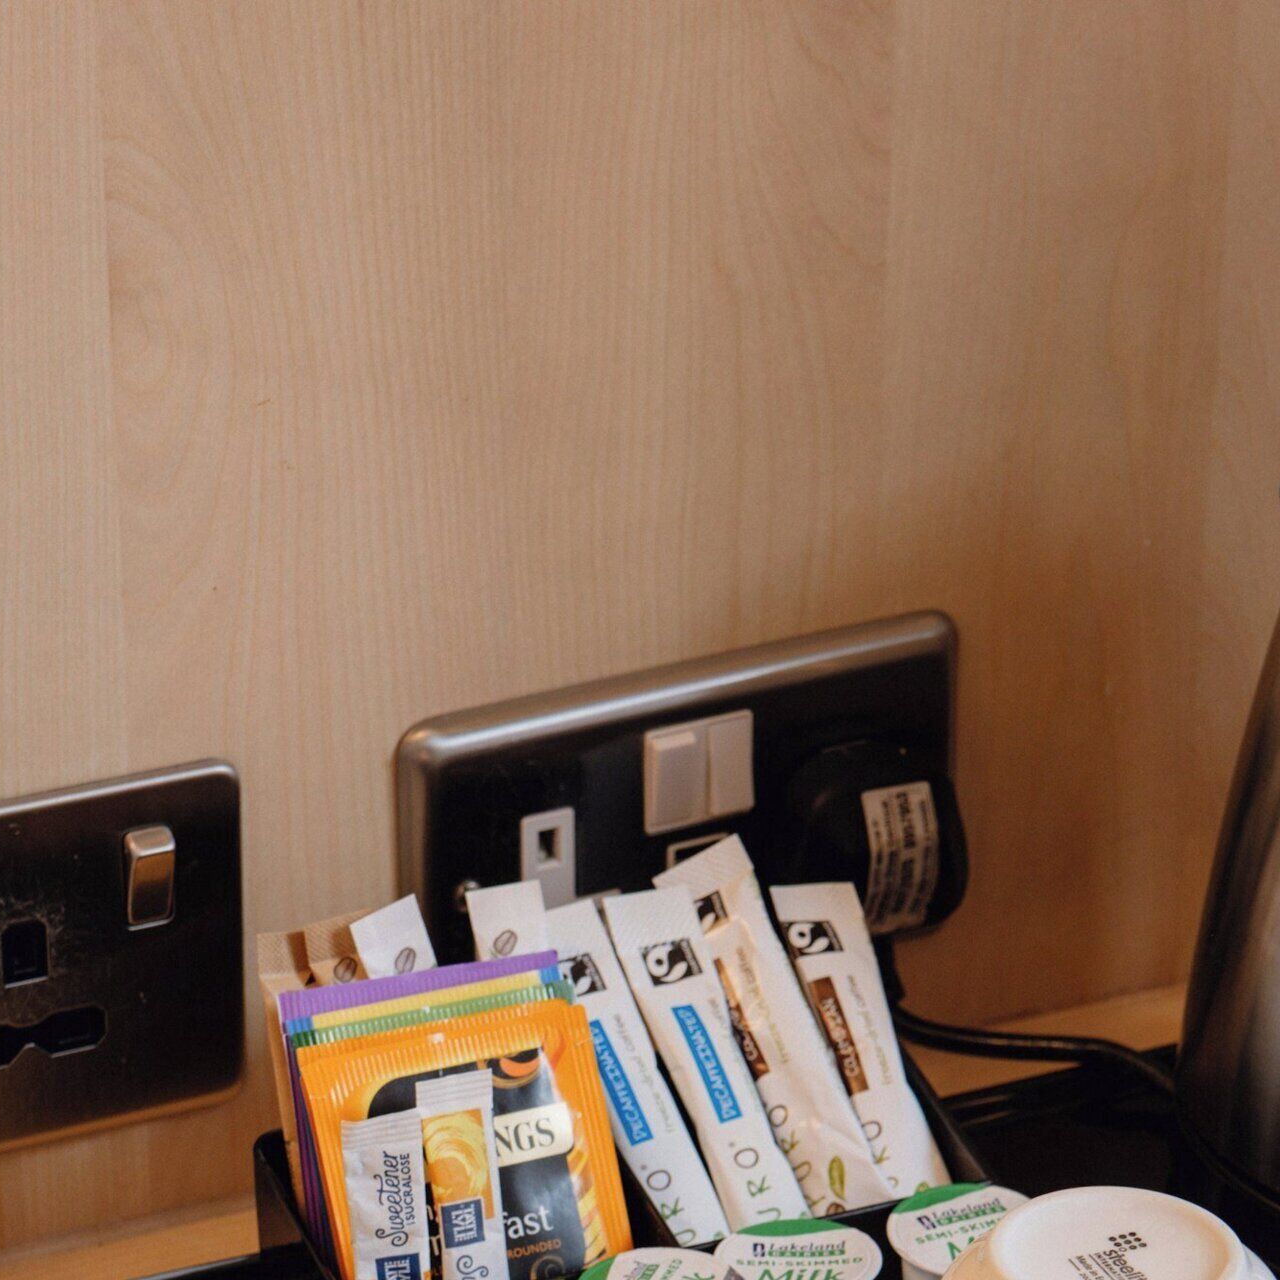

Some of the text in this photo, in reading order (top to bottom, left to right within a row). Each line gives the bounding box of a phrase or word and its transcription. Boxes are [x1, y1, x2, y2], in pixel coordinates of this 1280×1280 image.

[373, 1150, 409, 1247] Sweetener
[646, 1170, 696, 1245] URO
[734, 1148, 782, 1221] URO
[770, 1240, 846, 1251] Lakeland
[915, 1218, 1001, 1244] SEMI-SKIM
[736, 1256, 863, 1267] SEMI-SKIMMED
